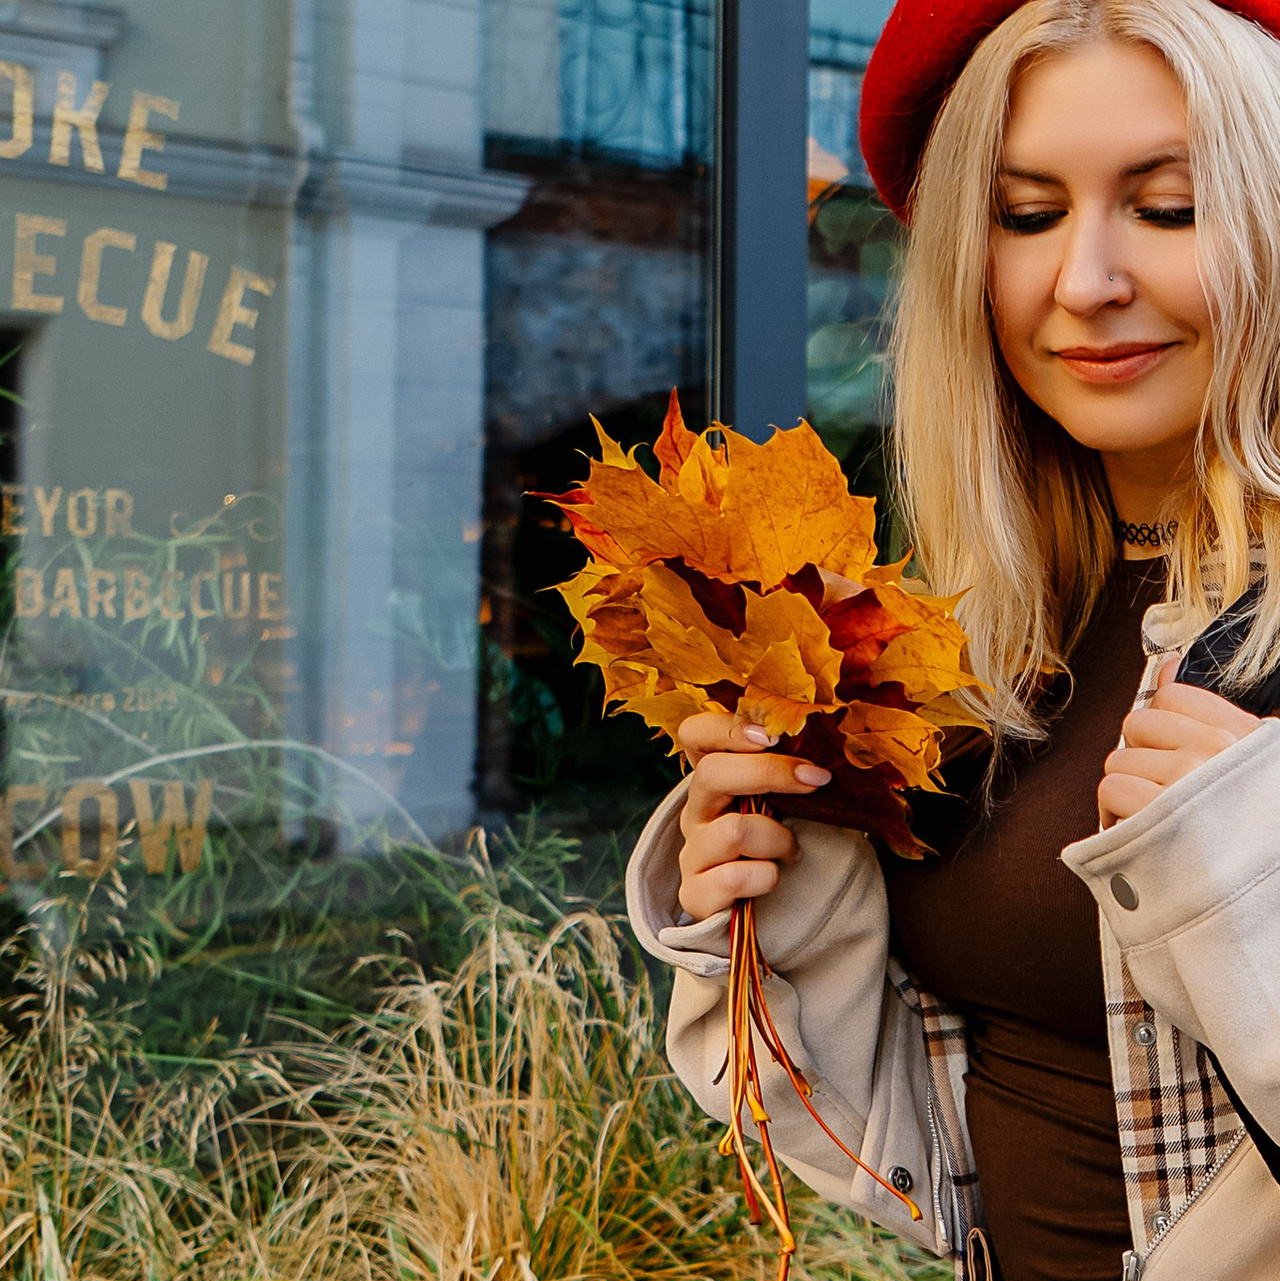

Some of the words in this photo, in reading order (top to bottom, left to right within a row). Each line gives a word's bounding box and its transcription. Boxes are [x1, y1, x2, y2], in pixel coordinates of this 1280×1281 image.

[11, 212, 276, 367] ECUE
[1, 484, 135, 538] EYOR
[14, 566, 288, 621] BARBECUE
